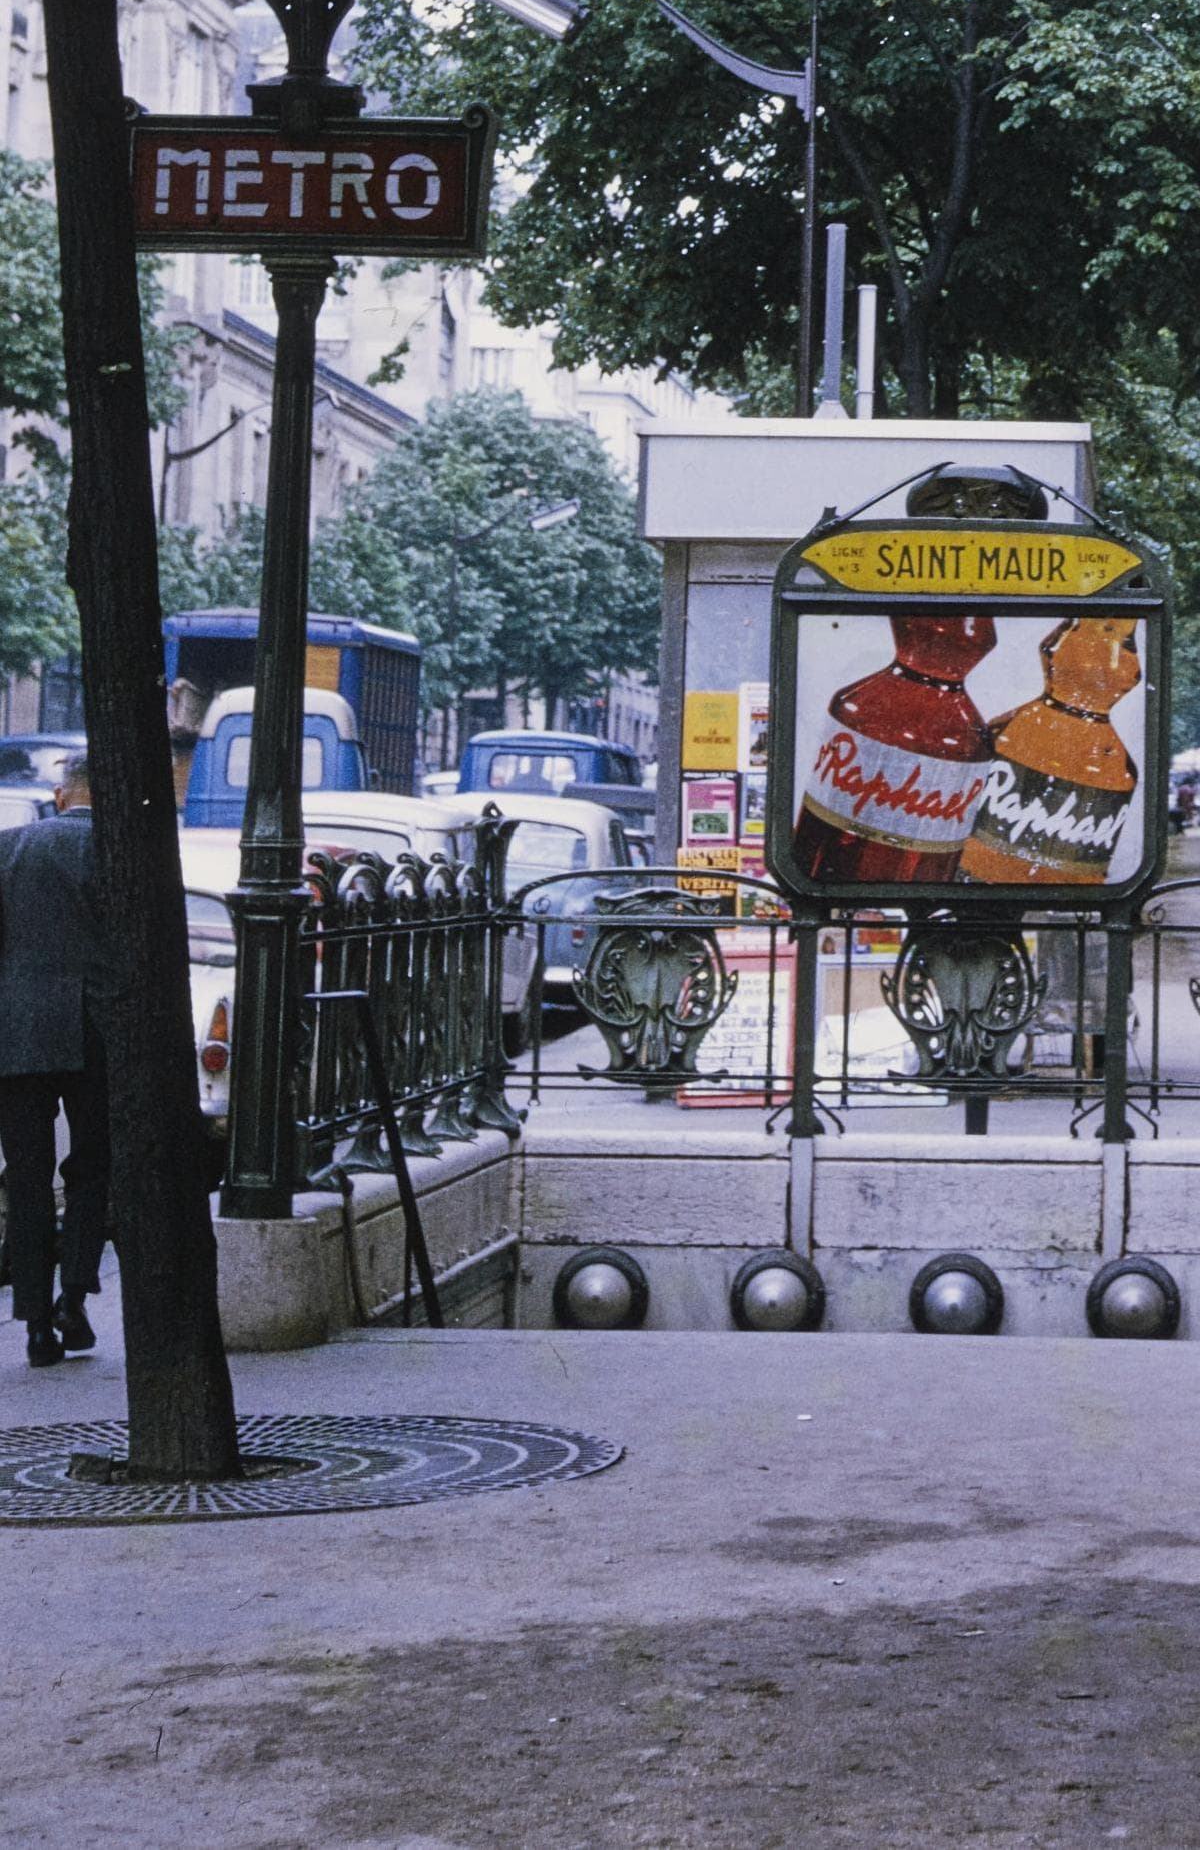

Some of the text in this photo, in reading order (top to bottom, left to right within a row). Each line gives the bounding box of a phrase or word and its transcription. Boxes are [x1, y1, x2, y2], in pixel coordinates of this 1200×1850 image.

[155, 147, 441, 220] METRO
[832, 547, 864, 558] LIGNE
[1078, 552, 1111, 564] LIGNE
[851, 563, 860, 574] 3
[876, 544, 1066, 582] SAINT MAUR
[1098, 569, 1106, 579] 3
